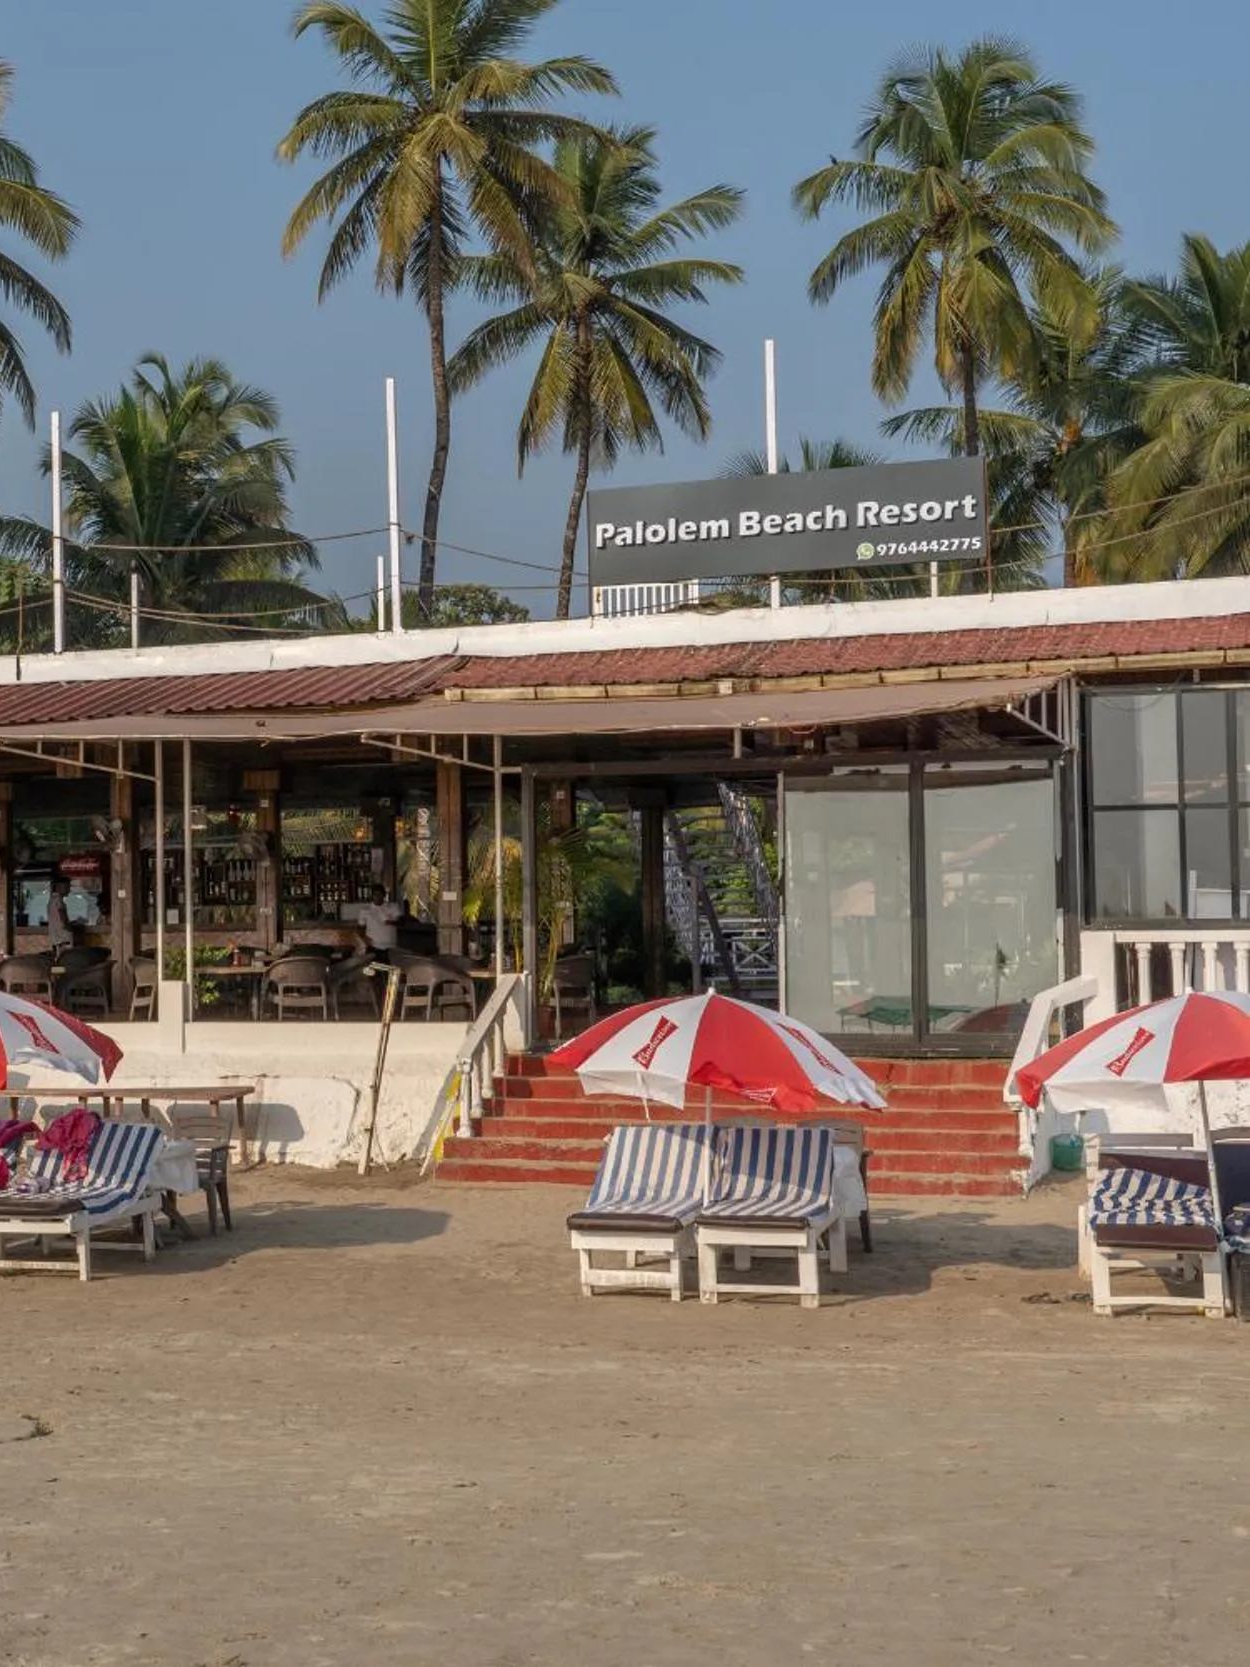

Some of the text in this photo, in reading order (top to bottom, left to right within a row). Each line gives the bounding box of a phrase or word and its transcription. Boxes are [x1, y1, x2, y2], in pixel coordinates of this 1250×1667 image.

[595, 494, 977, 548] Palolem Beach Resort
[876, 536, 982, 556] 9764442775
